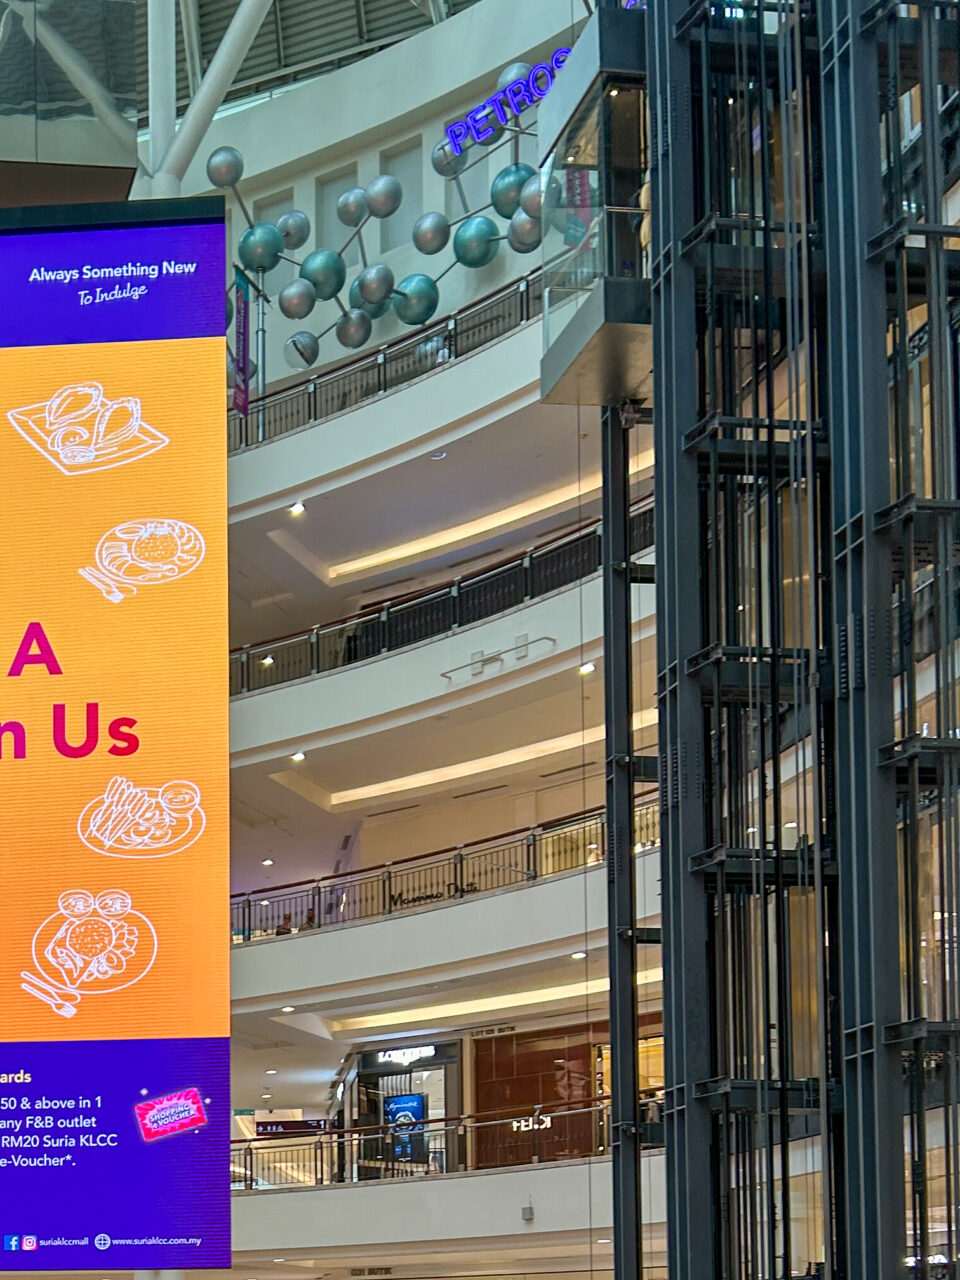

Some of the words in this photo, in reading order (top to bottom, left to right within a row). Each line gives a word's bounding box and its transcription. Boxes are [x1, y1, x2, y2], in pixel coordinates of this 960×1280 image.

[29, 267, 79, 282] Always
[82, 262, 159, 279] Something
[162, 260, 197, 274] New
[78, 291, 92, 305] To
[95, 282, 149, 303] Indulge
[7, 622, 63, 677] A
[53, 702, 140, 759] Us
[20, 1097, 31, 1110] &
[34, 1096, 75, 1109] above
[79, 1096, 91, 1109] in
[95, 1096, 102, 1108] 1
[149, 1103, 190, 1122] SHOPPING
[0, 1119, 21, 1133] any
[25, 1116, 54, 1129] F&B
[57, 1115, 97, 1128] outlet
[1, 1136, 39, 1148] RM20
[43, 1134, 76, 1147] Suria
[79, 1133, 118, 1147] KLCC
[39, 1237, 89, 1246] suriaklccmall
[112, 1237, 202, 1248] www.suriaklcc.com.my
